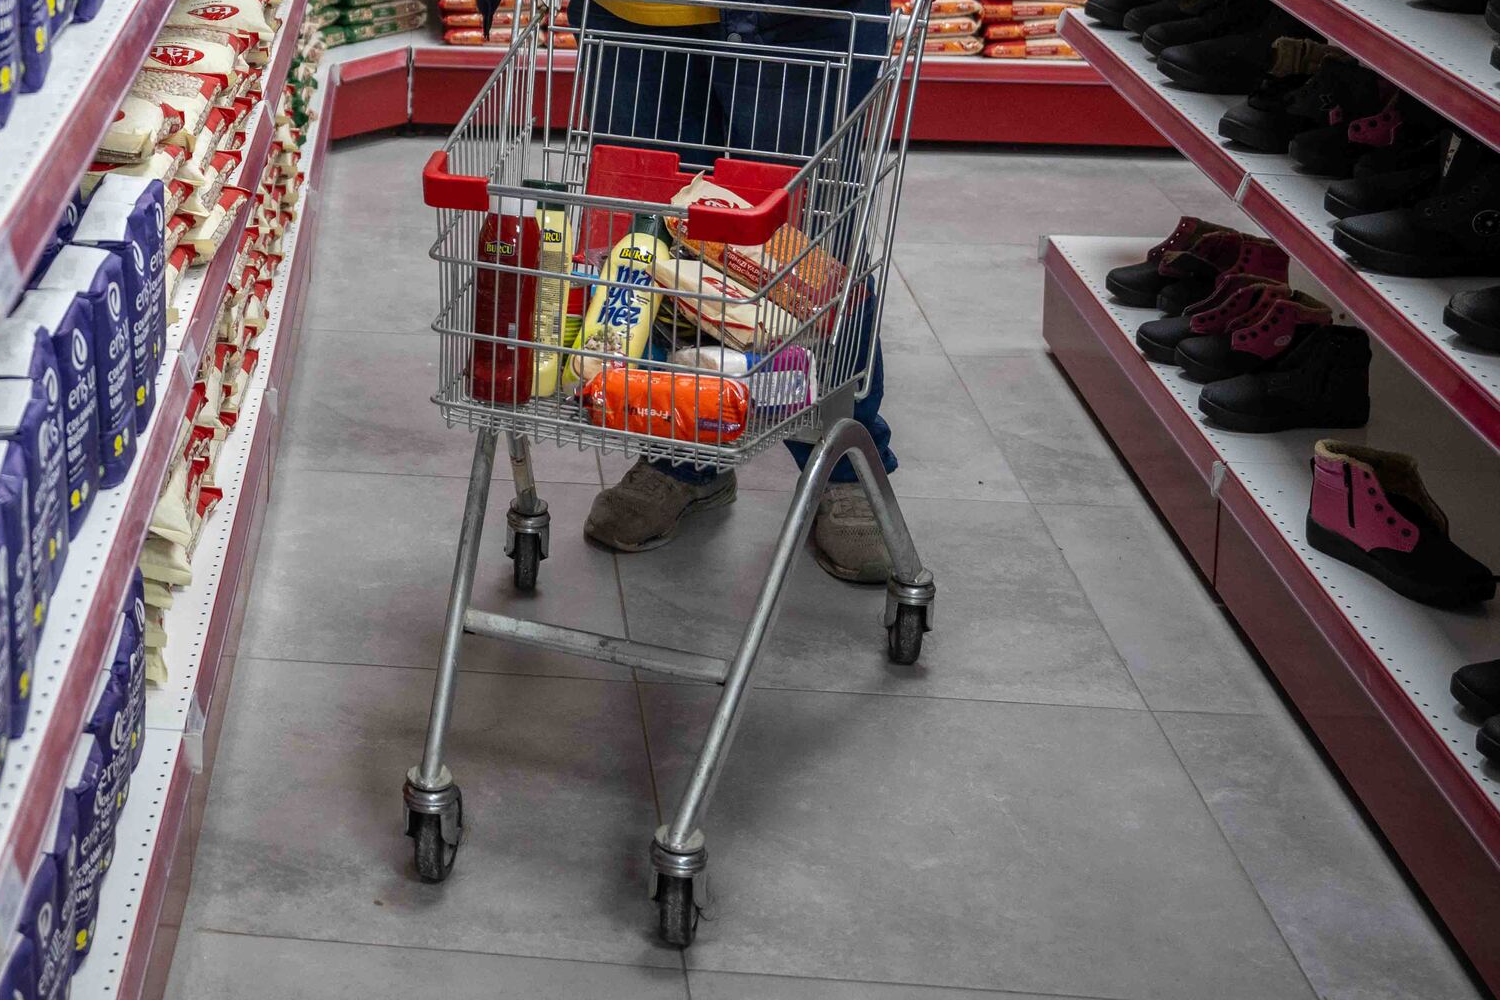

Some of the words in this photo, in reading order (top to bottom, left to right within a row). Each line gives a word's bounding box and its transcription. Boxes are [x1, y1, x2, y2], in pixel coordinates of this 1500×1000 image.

[194, 6, 233, 17] tat
[151, 45, 197, 61] tat
[596, 306, 642, 327] nez
[637, 407, 669, 420] Fresh
